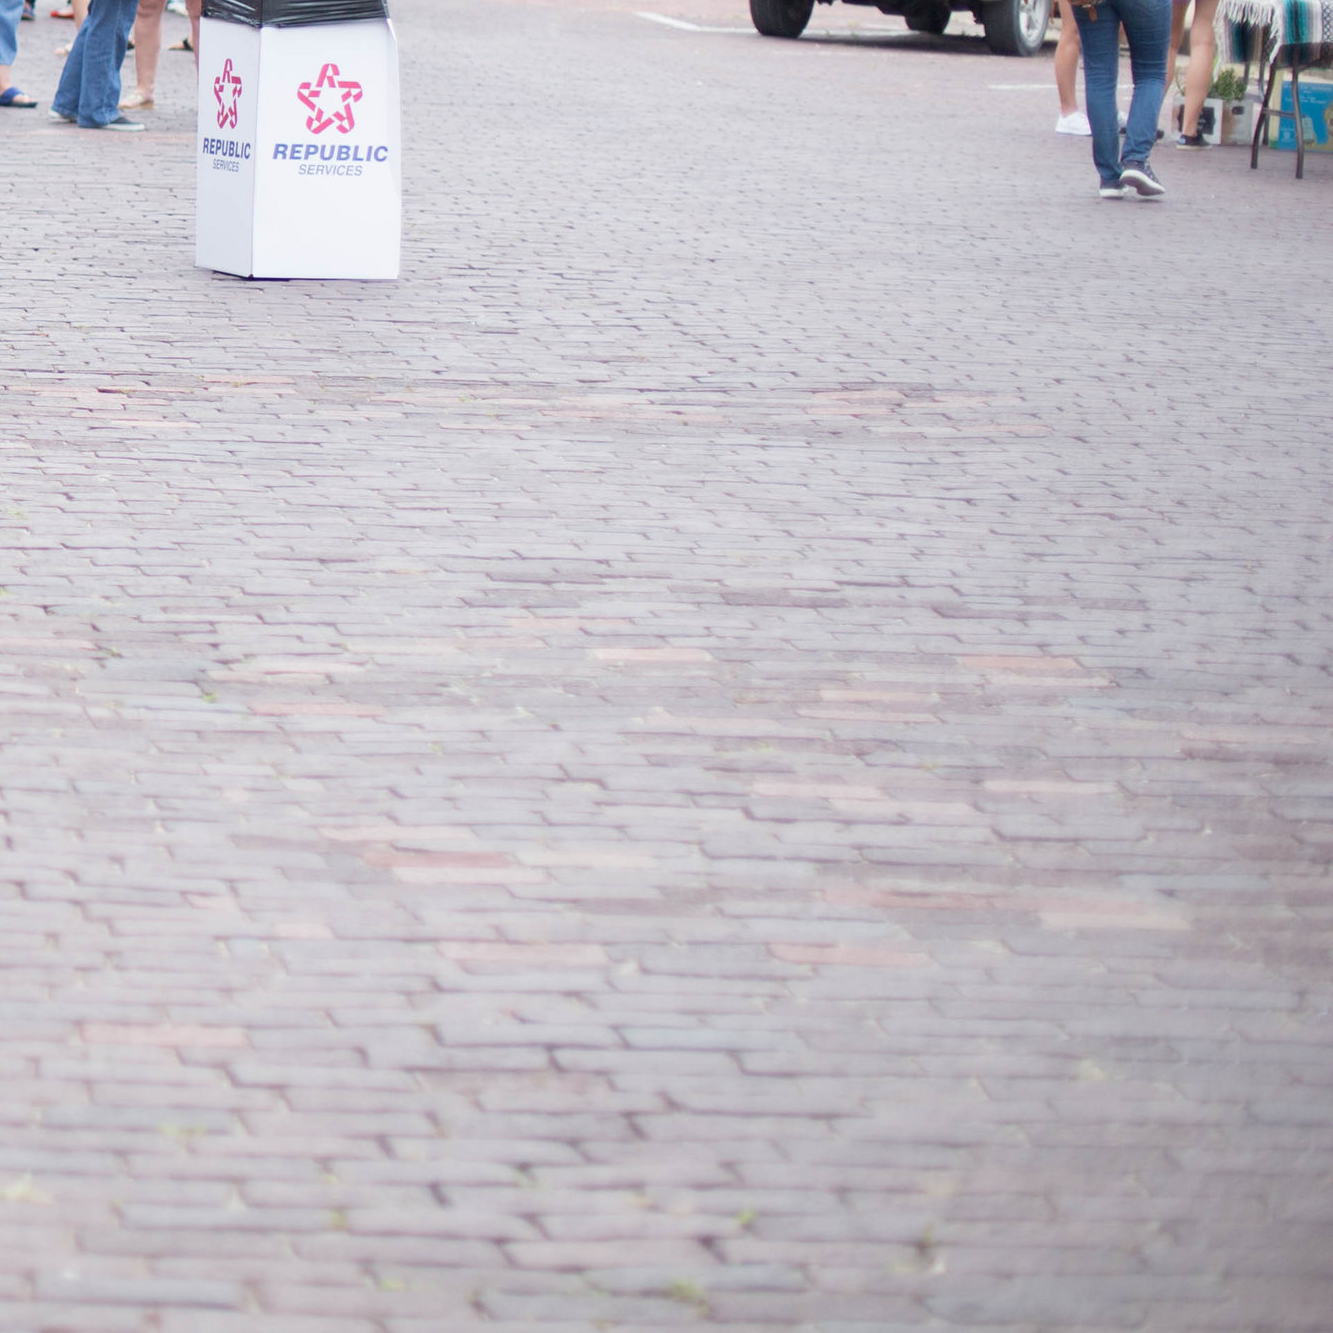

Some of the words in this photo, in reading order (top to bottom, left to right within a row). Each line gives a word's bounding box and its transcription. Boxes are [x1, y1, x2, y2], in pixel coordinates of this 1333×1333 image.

[203, 137, 251, 159] REPUBLIC
[272, 143, 389, 162] REPUBLIC
[213, 158, 240, 172] SERVICES
[298, 163, 363, 176] SERVICES
